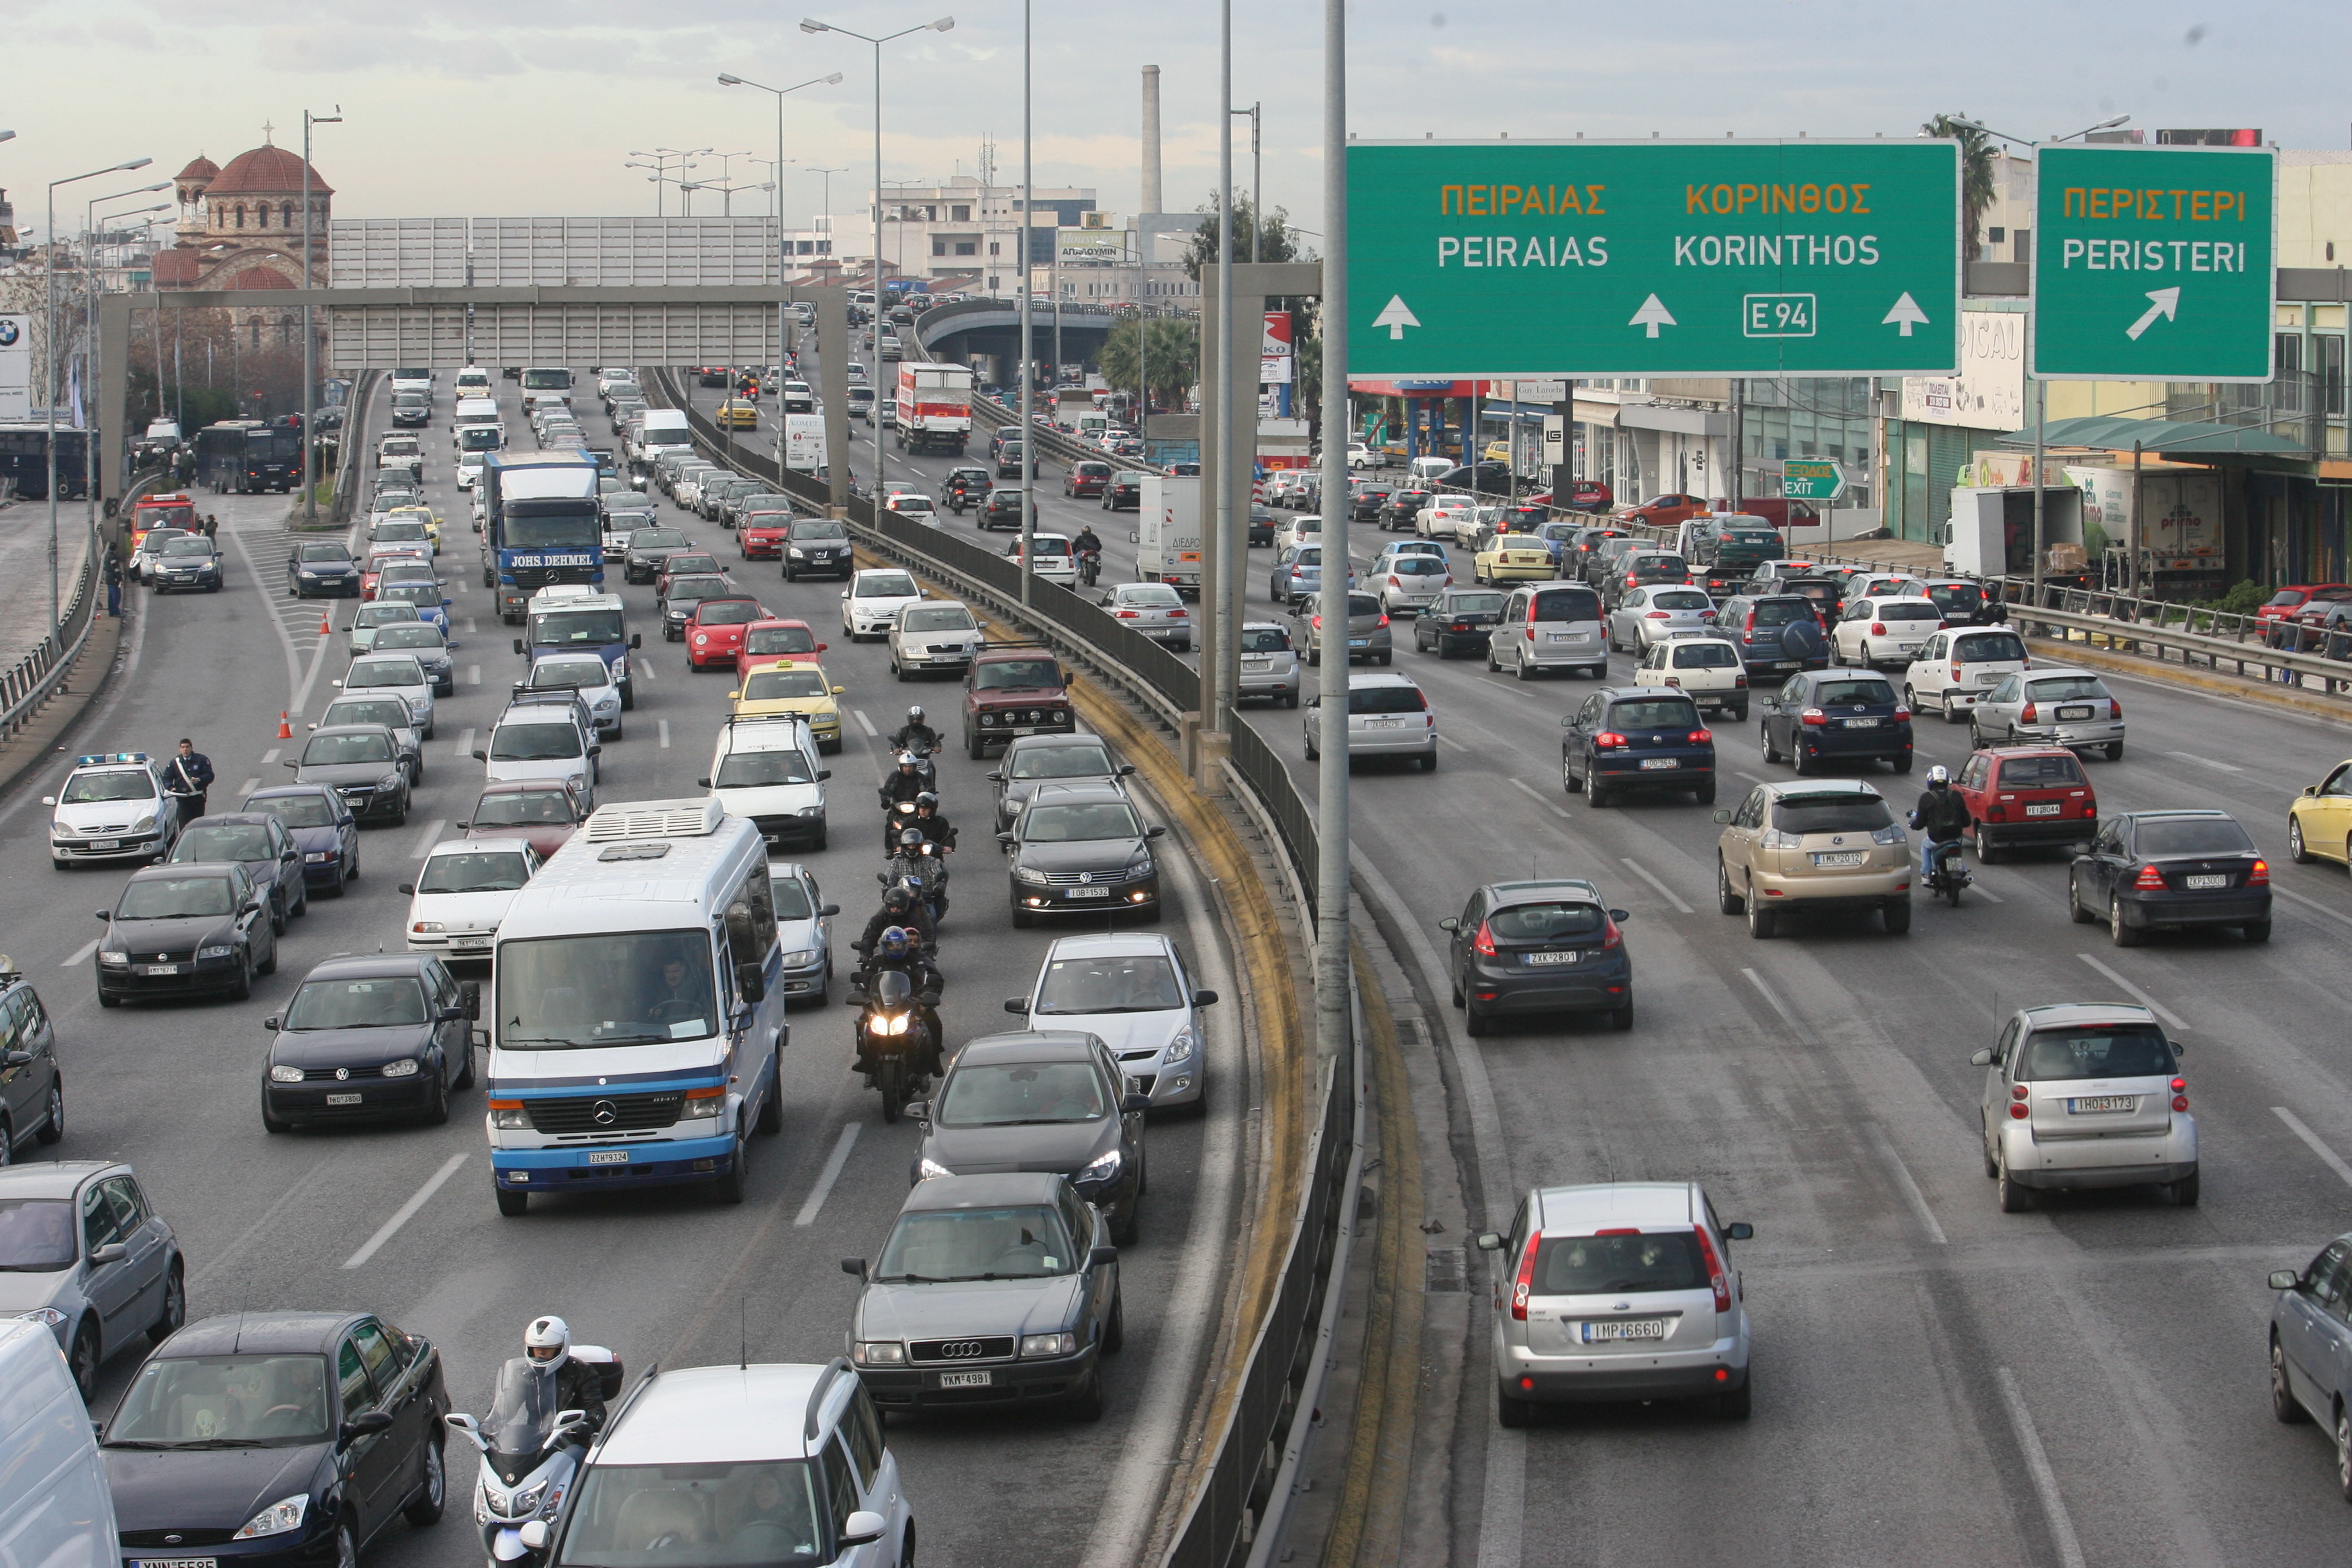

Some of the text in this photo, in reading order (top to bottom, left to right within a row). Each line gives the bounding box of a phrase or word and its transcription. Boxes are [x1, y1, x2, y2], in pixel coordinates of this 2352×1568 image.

[1442, 185, 1604, 215] ΠΕΙΡΑΙΑΣ
[1687, 184, 1869, 213] ΚΟΡΙΝΘΟΣ
[2065, 188, 2243, 220] ΠΕΡΙΣΤΕΡΙ
[1439, 236, 1608, 266] PEIRAIAS
[1675, 235, 1879, 265] KORINTHOS
[2064, 239, 2243, 271] PERISTERI
[1752, 303, 1808, 329] E 94
[1263, 346, 1285, 354] KO
[1518, 385, 1565, 396] Guy Laroche
[1785, 464, 1833, 477] ΕΞΟΔΟΣ
[2043, 468, 2051, 484] elle
[1785, 481, 1814, 495] EXIT
[2161, 517, 2202, 530] primo
[511, 554, 593, 567] JOHS. DEHMEL
